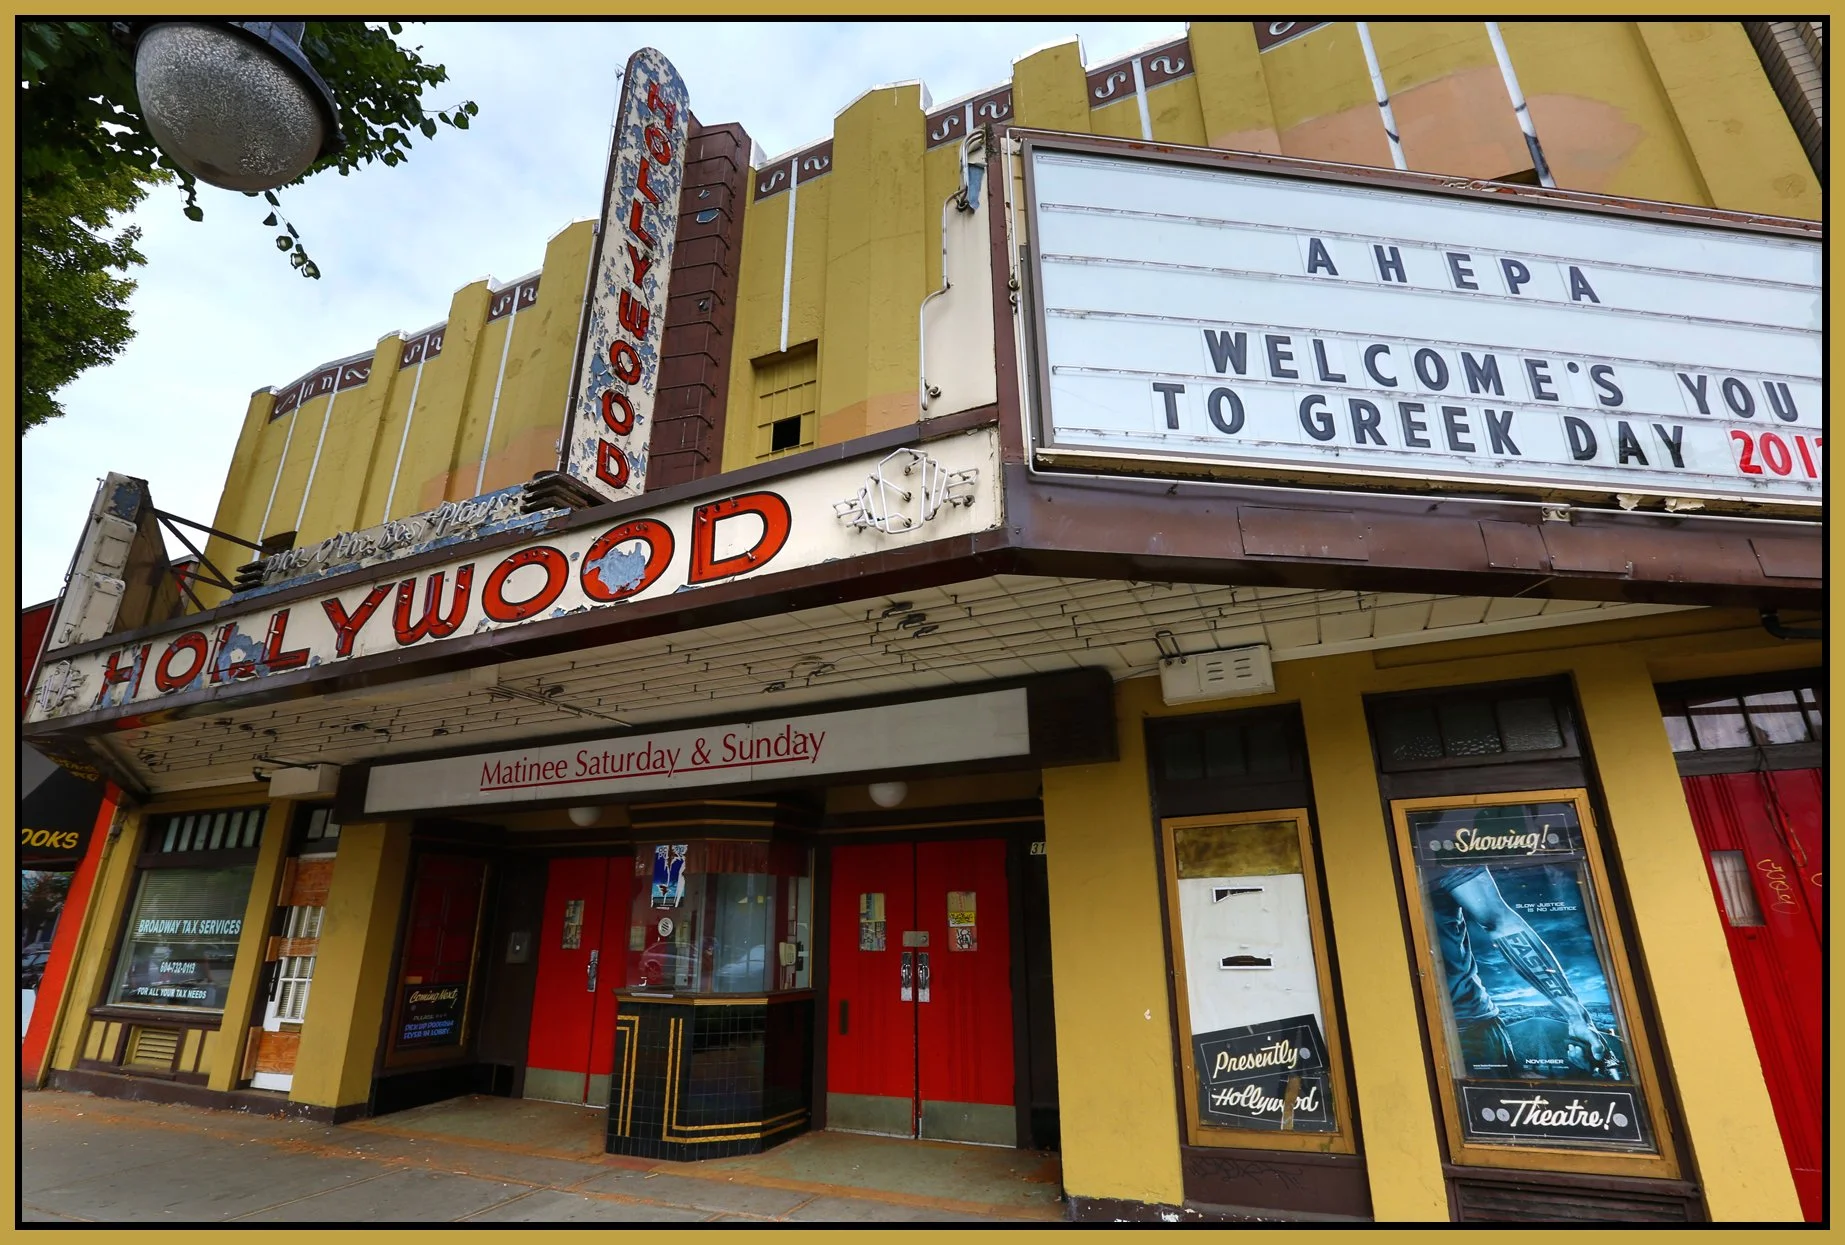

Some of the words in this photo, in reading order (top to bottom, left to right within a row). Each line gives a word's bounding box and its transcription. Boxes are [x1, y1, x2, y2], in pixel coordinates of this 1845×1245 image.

[596, 81, 677, 490] HOLLYWOOD
[1678, 372, 1799, 423] YOU
[1152, 382, 1245, 435] TO
[1299, 394, 1522, 456] GREEK
[1564, 415, 1686, 468] DAY
[97, 490, 793, 705] HOLLYWOOD
[480, 757, 568, 787] Matinee
[575, 741, 681, 778] Saturday
[691, 738, 712, 766] &
[722, 724, 826, 763] Sunday
[1454, 824, 1550, 856] Showing!
[139, 919, 181, 934] BROADWAY
[182, 920, 199, 934] TAX
[199, 920, 241, 935] SERVICES
[1506, 931, 1567, 999] FASTER
[137, 987, 148, 996] FOR
[149, 987, 159, 996] ALL
[160, 988, 176, 997] YOUR
[176, 989, 187, 998] TAX
[187, 990, 207, 999] NEEDS
[1213, 1039, 1299, 1079] Presently
[1500, 1095, 1616, 1130] Theatre!
